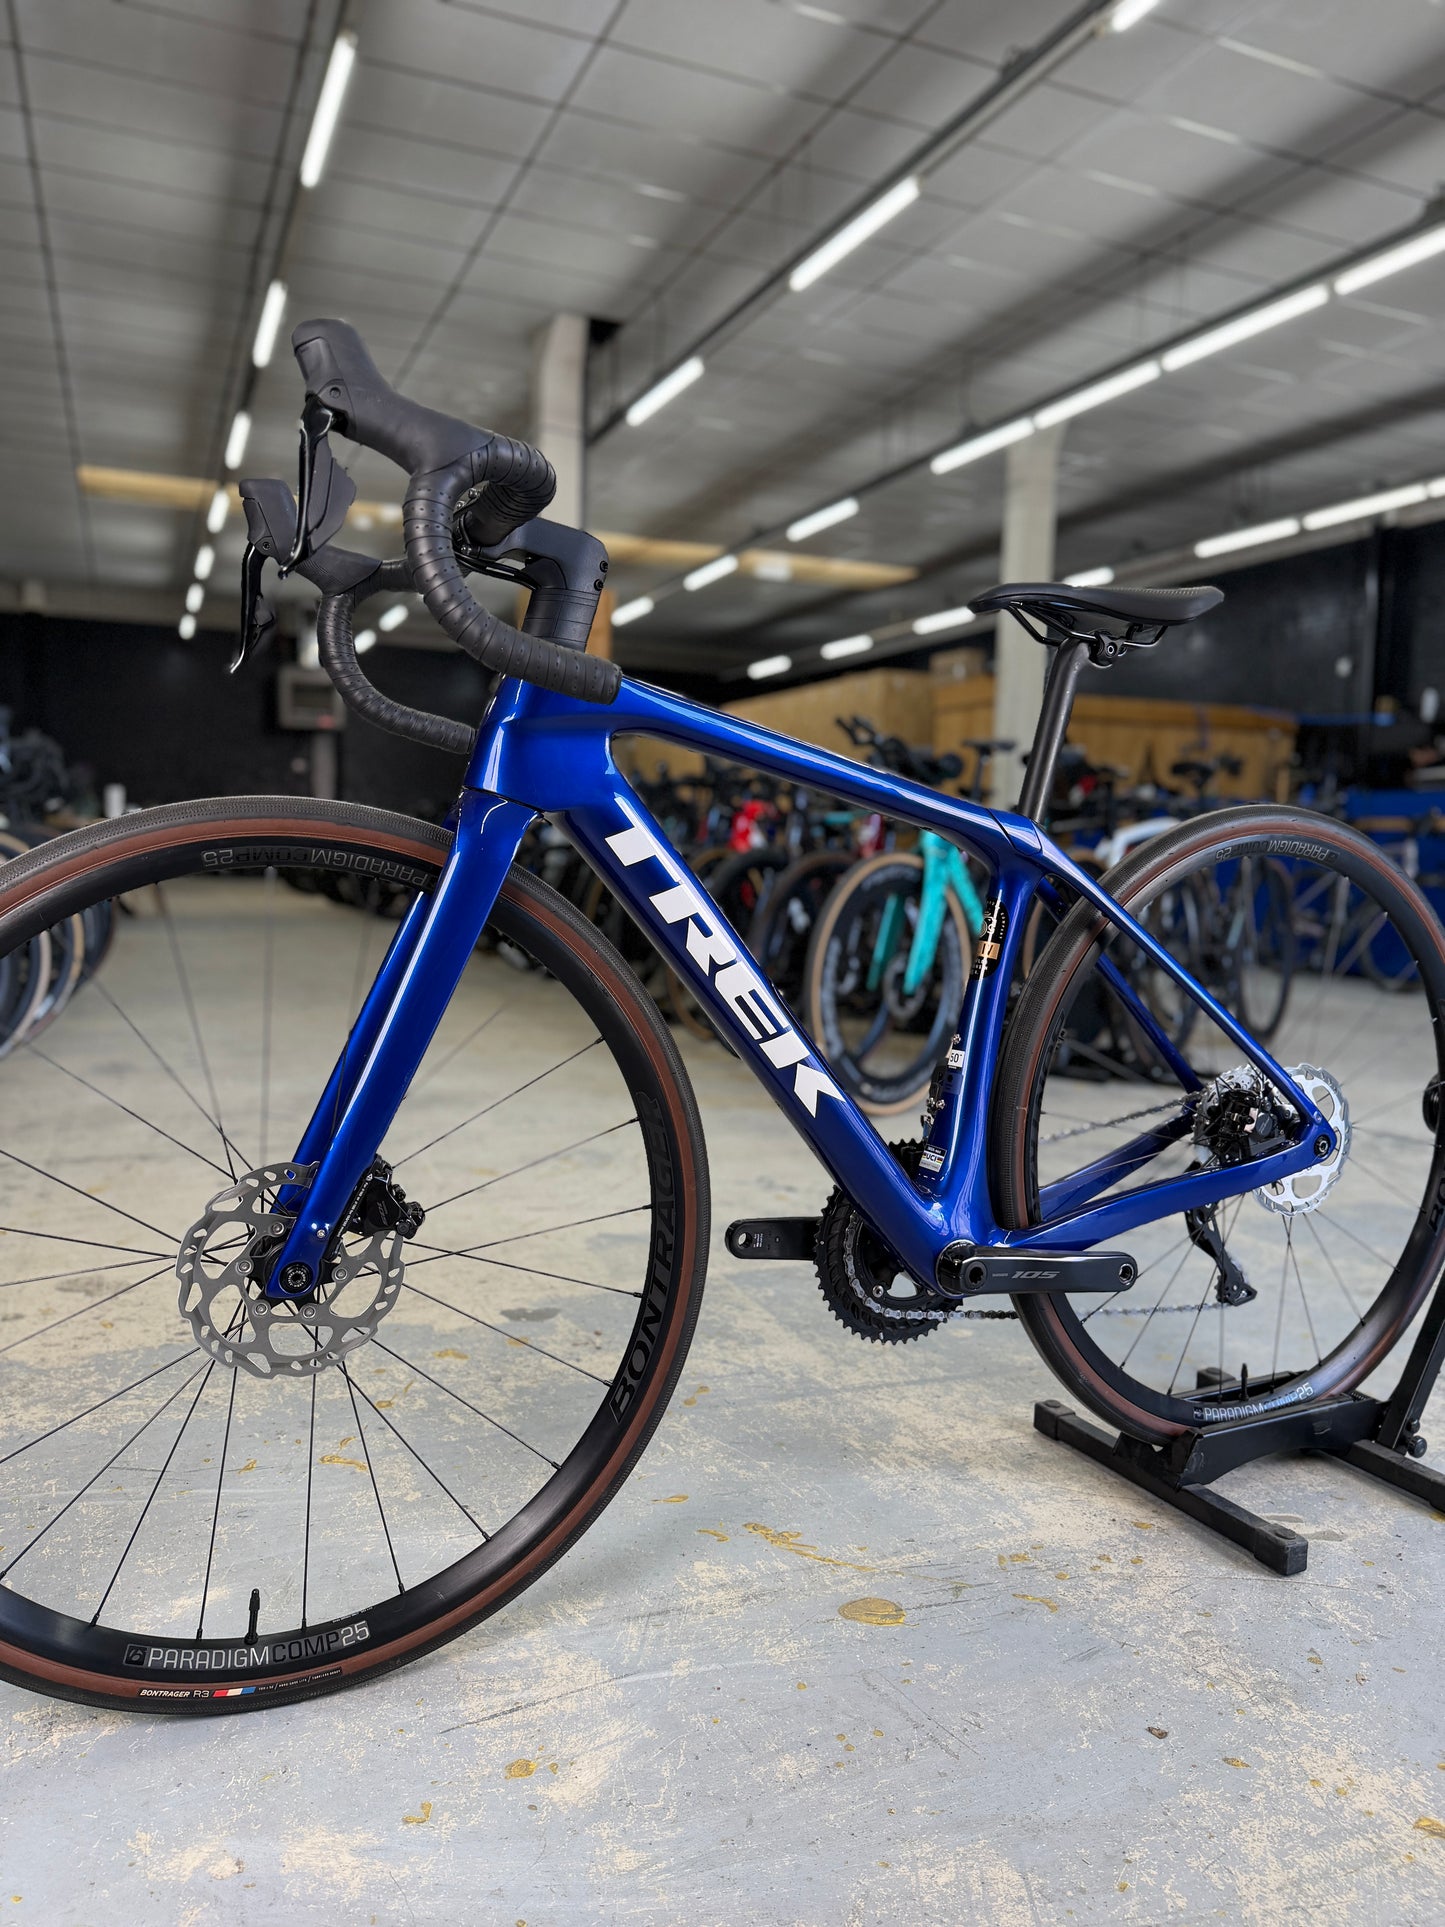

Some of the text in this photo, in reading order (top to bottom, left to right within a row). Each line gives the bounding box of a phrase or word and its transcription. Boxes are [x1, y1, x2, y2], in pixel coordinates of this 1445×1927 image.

[605, 795, 846, 1118] TREK
[926, 1153, 937, 1162] UCI
[609, 1090, 675, 1424] BONTRAGER
[1011, 1270, 1061, 1279] 105
[140, 1689, 210, 1698] BONTRAGER R3
